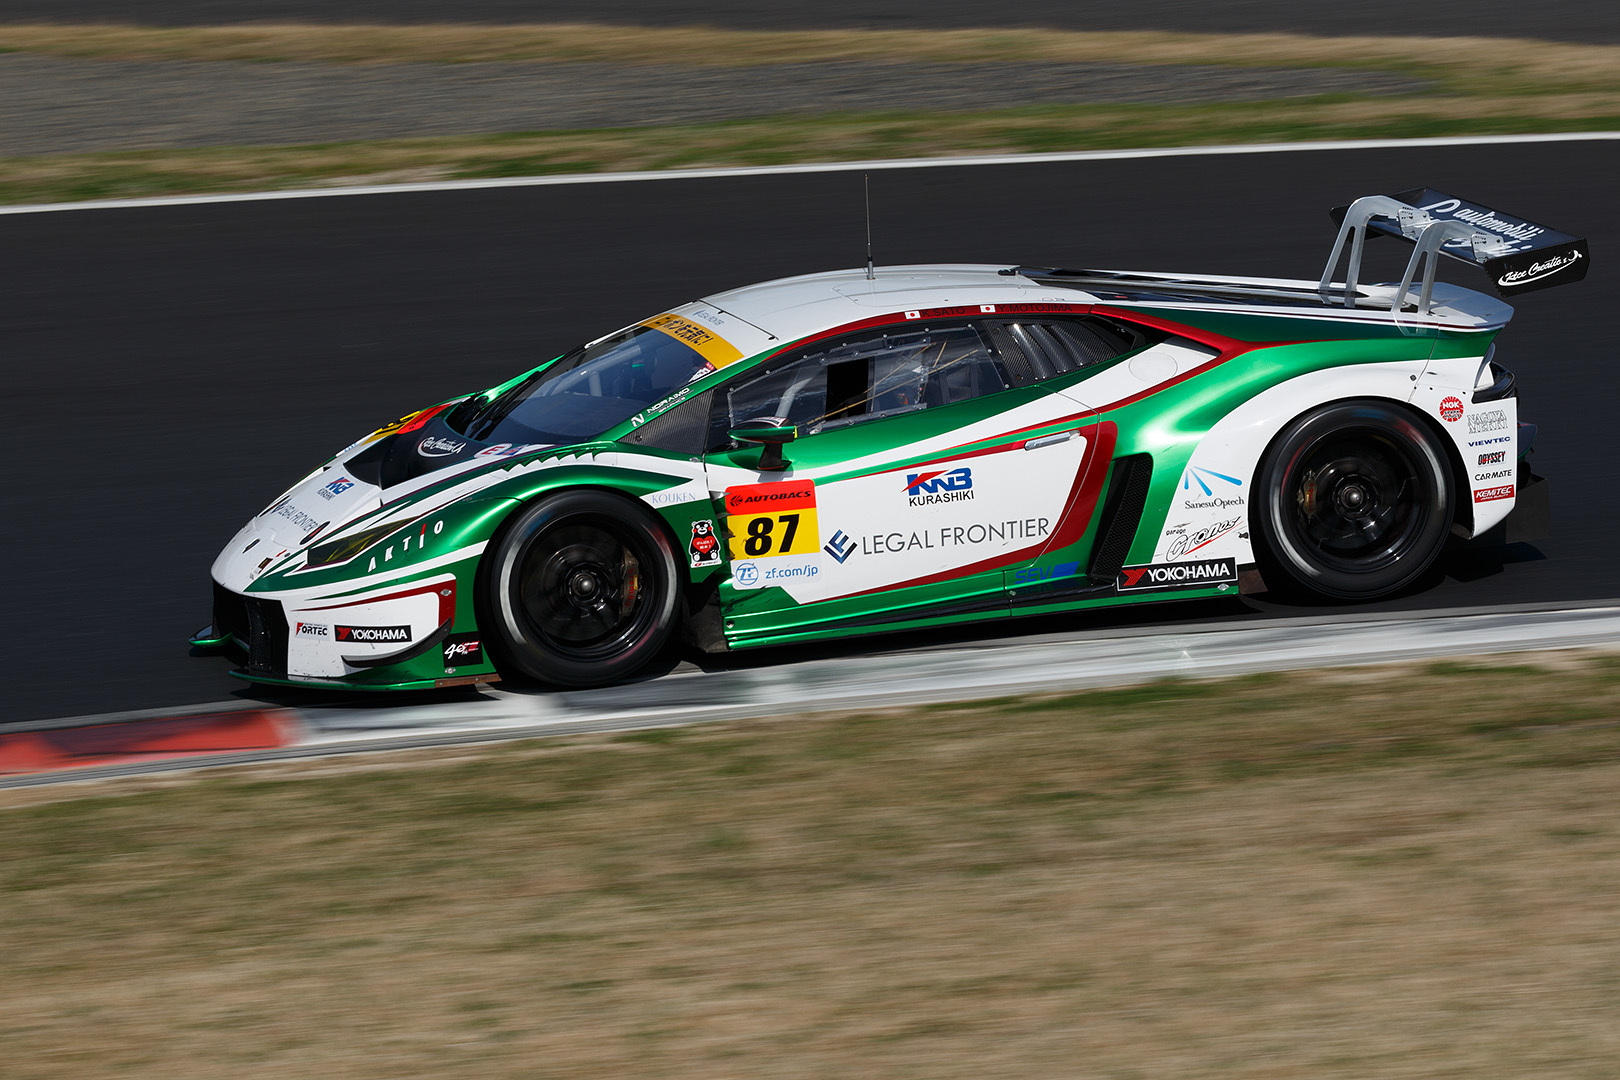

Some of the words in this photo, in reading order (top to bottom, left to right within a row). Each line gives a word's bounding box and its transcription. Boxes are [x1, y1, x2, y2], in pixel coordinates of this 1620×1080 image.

[1453, 207, 1545, 241] automobili
[922, 307, 965, 318] K.SATO
[999, 303, 1072, 312] Y.MOTOJIMA
[1468, 436, 1511, 447] VIEWTEC
[1478, 451, 1506, 466] ODYSSEY
[1475, 469, 1512, 481] CARMATE
[652, 492, 696, 504] KOUKEN
[744, 490, 811, 503] AUTOBACS
[909, 490, 974, 507] KURASHIKI
[1476, 486, 1513, 499] KEMITEC
[1185, 497, 1245, 509] SanesuOptech
[744, 514, 800, 556] 87
[863, 530, 934, 555] LEGAL
[941, 517, 1049, 547] FRONTIER
[367, 520, 443, 573] AKTIO
[765, 565, 819, 580] zf.com/jp
[1015, 565, 1051, 584] SEV
[1148, 563, 1231, 582] YOKOHAMA
[296, 622, 328, 636] FORTEC
[351, 628, 408, 640] YOKOHAMA
